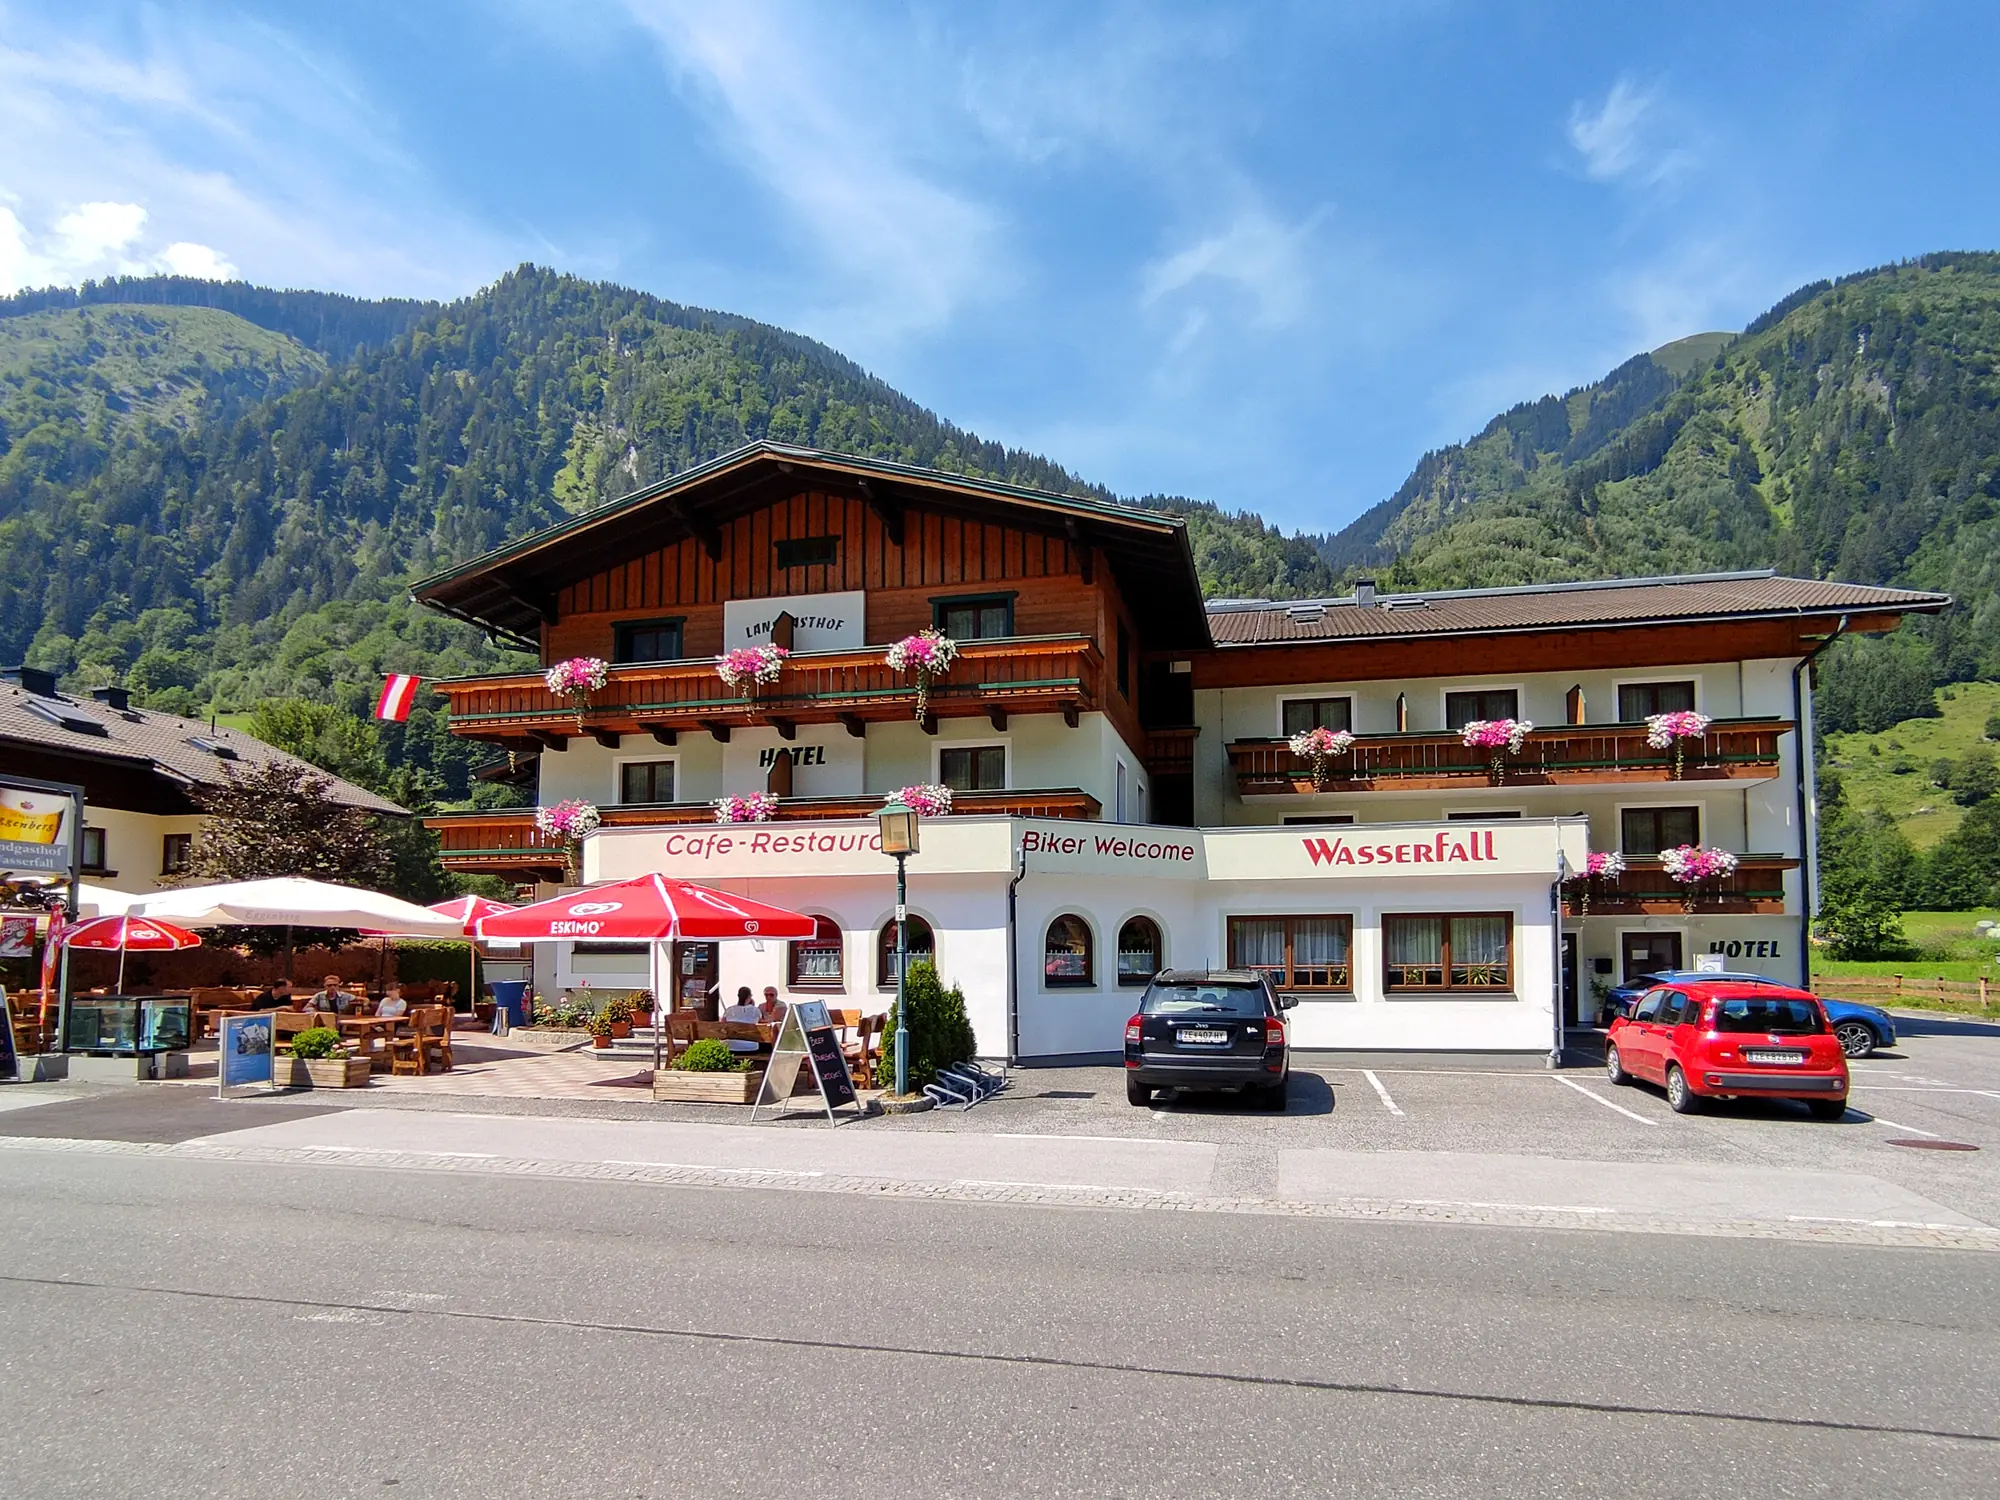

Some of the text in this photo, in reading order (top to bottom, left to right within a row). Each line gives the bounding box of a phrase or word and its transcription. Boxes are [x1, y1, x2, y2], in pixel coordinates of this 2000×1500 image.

[745, 616, 845, 638] LANASTHOF
[759, 745, 826, 767] HTEL
[1022, 831, 1195, 861] Biker Welcome
[0, 855, 54, 868] asserfall
[551, 921, 600, 934] ESKIMO
[1709, 940, 1781, 958] HOTEL
